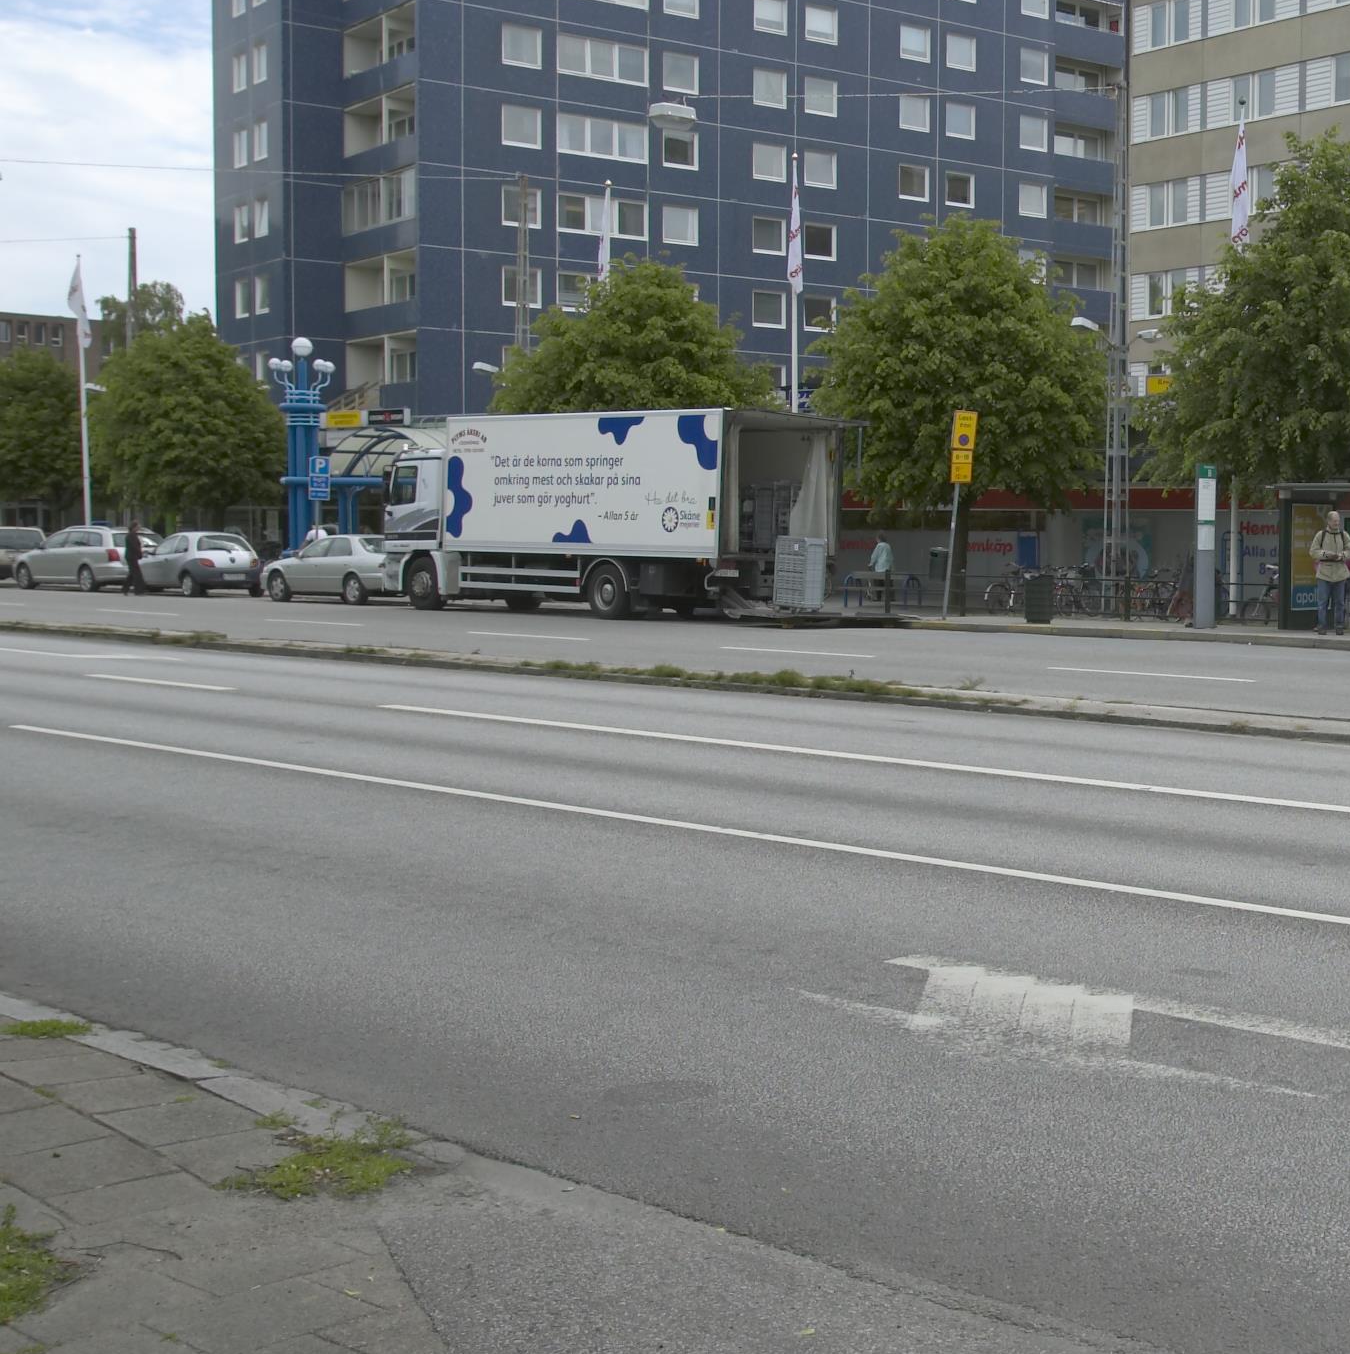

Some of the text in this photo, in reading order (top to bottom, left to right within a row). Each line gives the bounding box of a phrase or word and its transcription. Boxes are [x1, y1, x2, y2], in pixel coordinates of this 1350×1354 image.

[315, 458, 326, 473] P
[512, 455, 521, 467] är
[523, 454, 535, 467] de
[536, 455, 562, 467] korna
[564, 457, 583, 467] som
[585, 455, 624, 469] springer
[494, 473, 641, 488] omkring mest och skakar på sina
[493, 492, 515, 506] juver
[517, 494, 535, 504] som
[537, 492, 552, 507] gör
[604, 510, 623, 521] Allan
[624, 511, 629, 521] 5
[679, 510, 701, 521] Skåne
